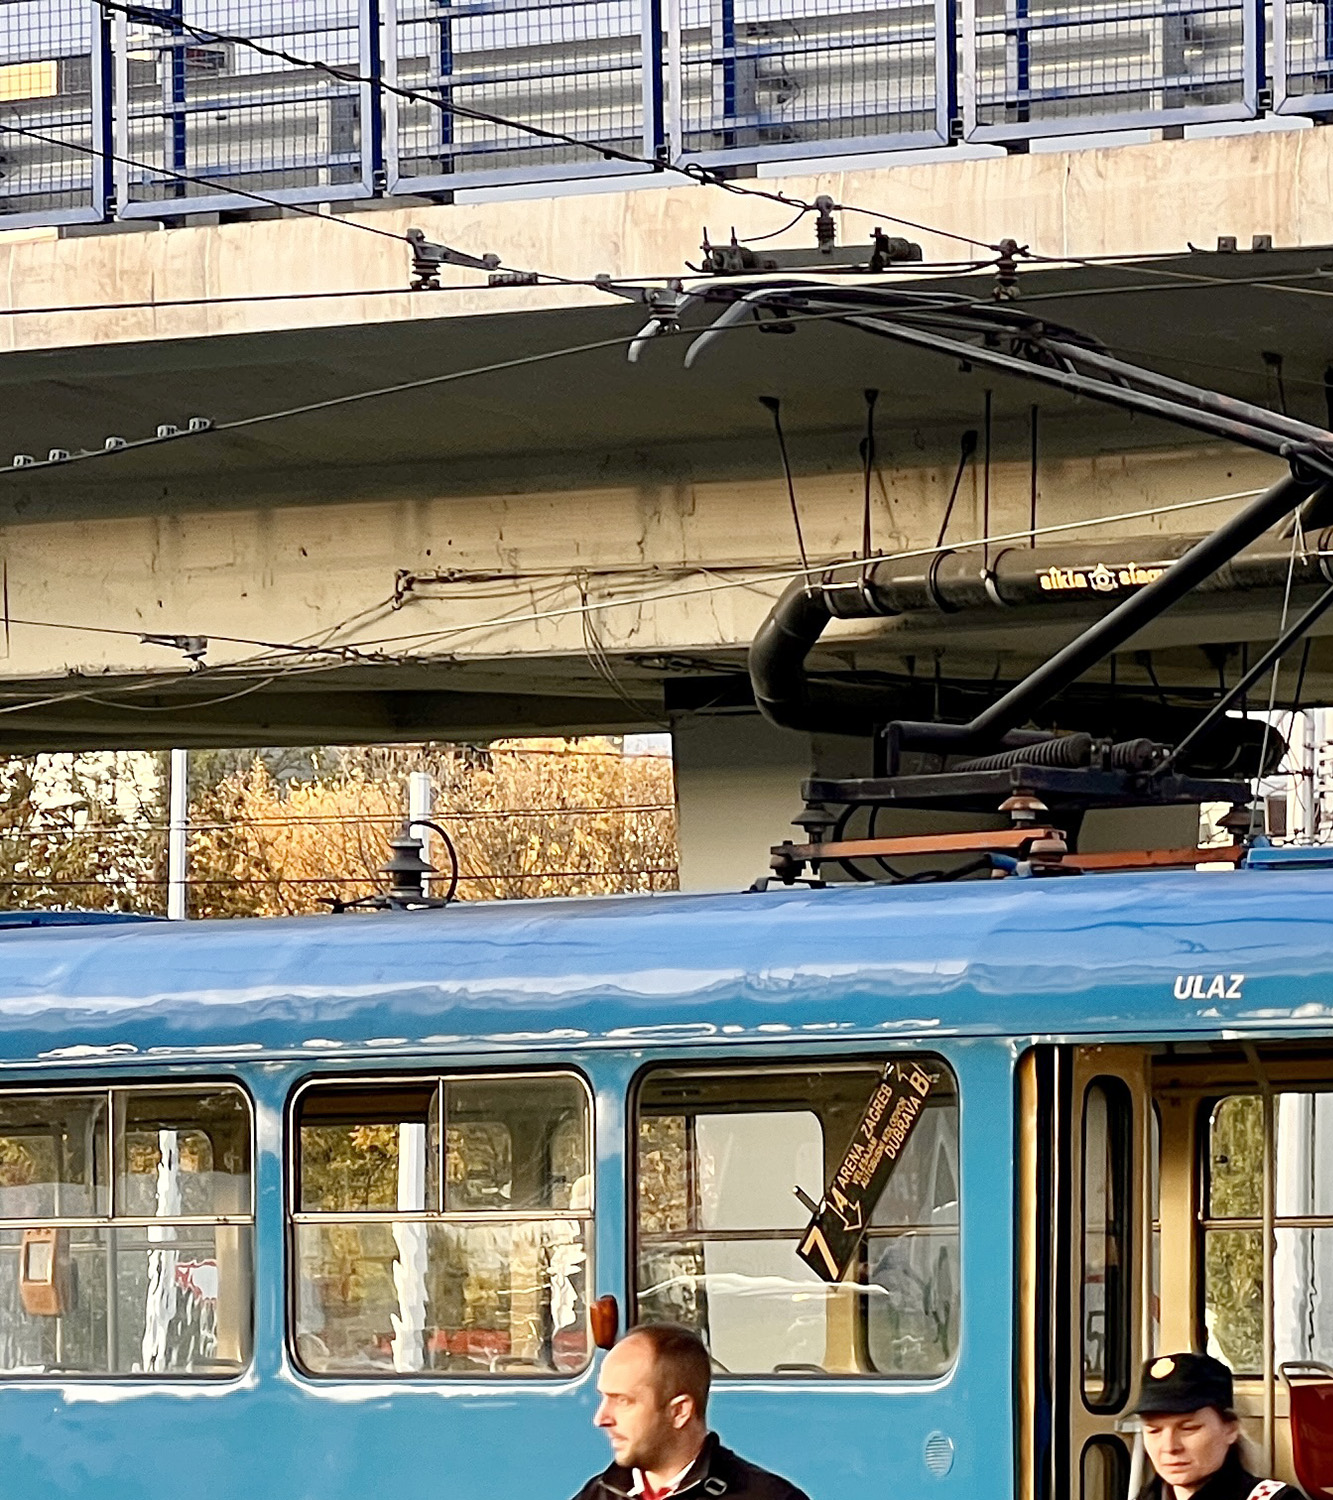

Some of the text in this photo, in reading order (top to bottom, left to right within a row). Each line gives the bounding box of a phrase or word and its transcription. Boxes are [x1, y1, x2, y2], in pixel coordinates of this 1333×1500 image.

[1174, 974, 1245, 999] ULAZ
[910, 1071, 931, 1097] B
[836, 1083, 893, 1189] ARENA ZAGREB
[885, 1096, 921, 1160] DUBRAVA
[801, 1225, 840, 1281] 7
